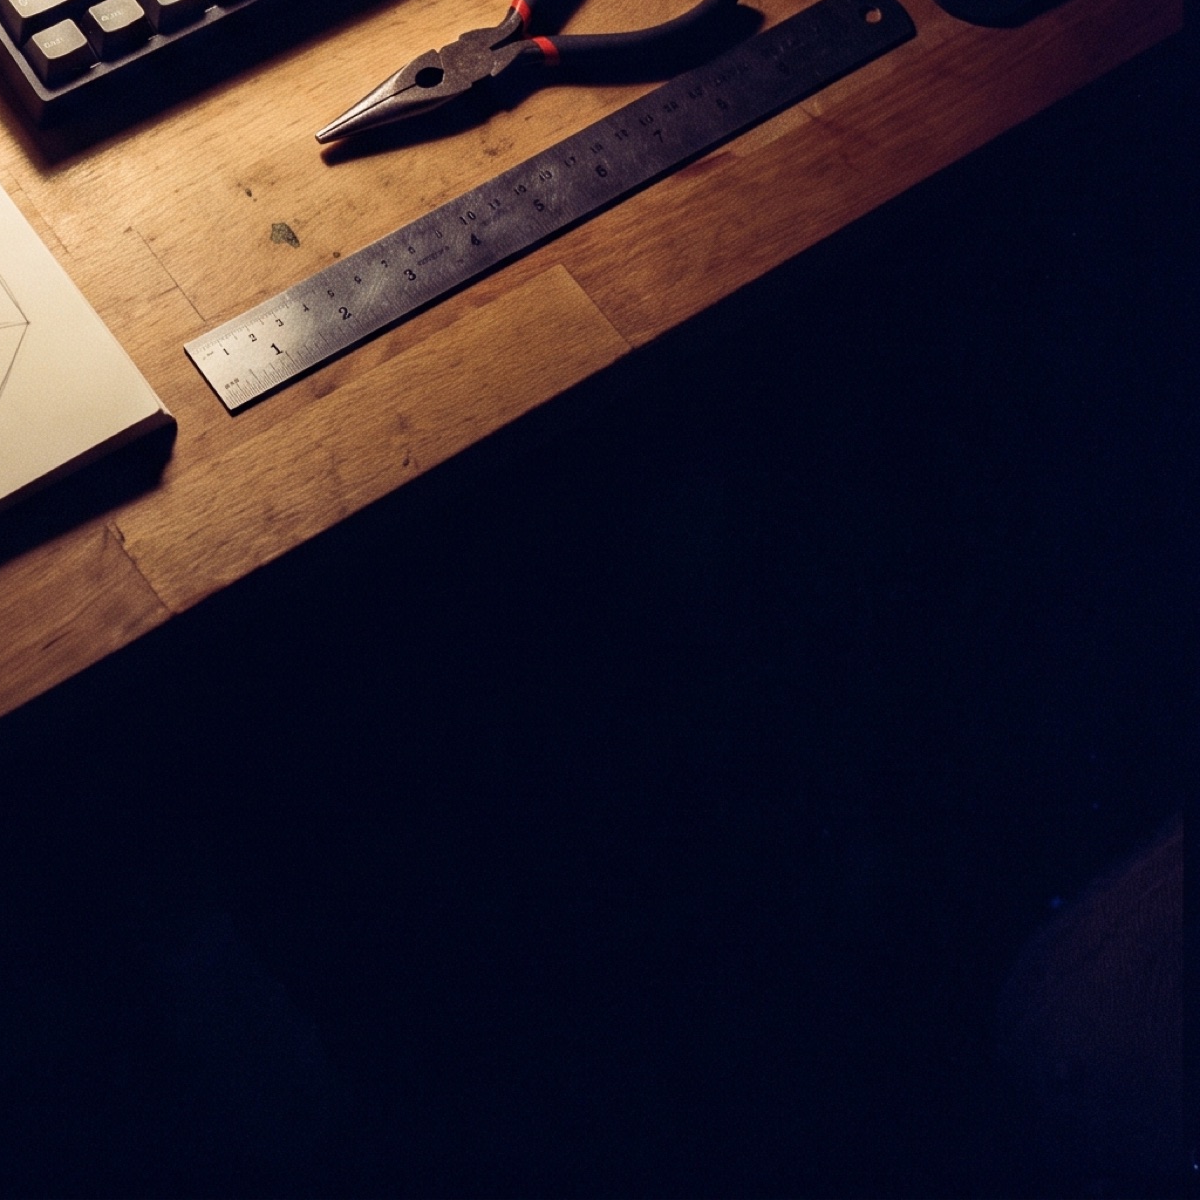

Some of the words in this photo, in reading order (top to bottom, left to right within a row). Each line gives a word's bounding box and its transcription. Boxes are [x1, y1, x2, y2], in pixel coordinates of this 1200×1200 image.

[270, 342, 283, 356] 1
[338, 306, 352, 320] 2
[404, 269, 417, 281] 3
[532, 199, 546, 212] 5
[594, 164, 608, 178] 6
[652, 129, 664, 144] 7
